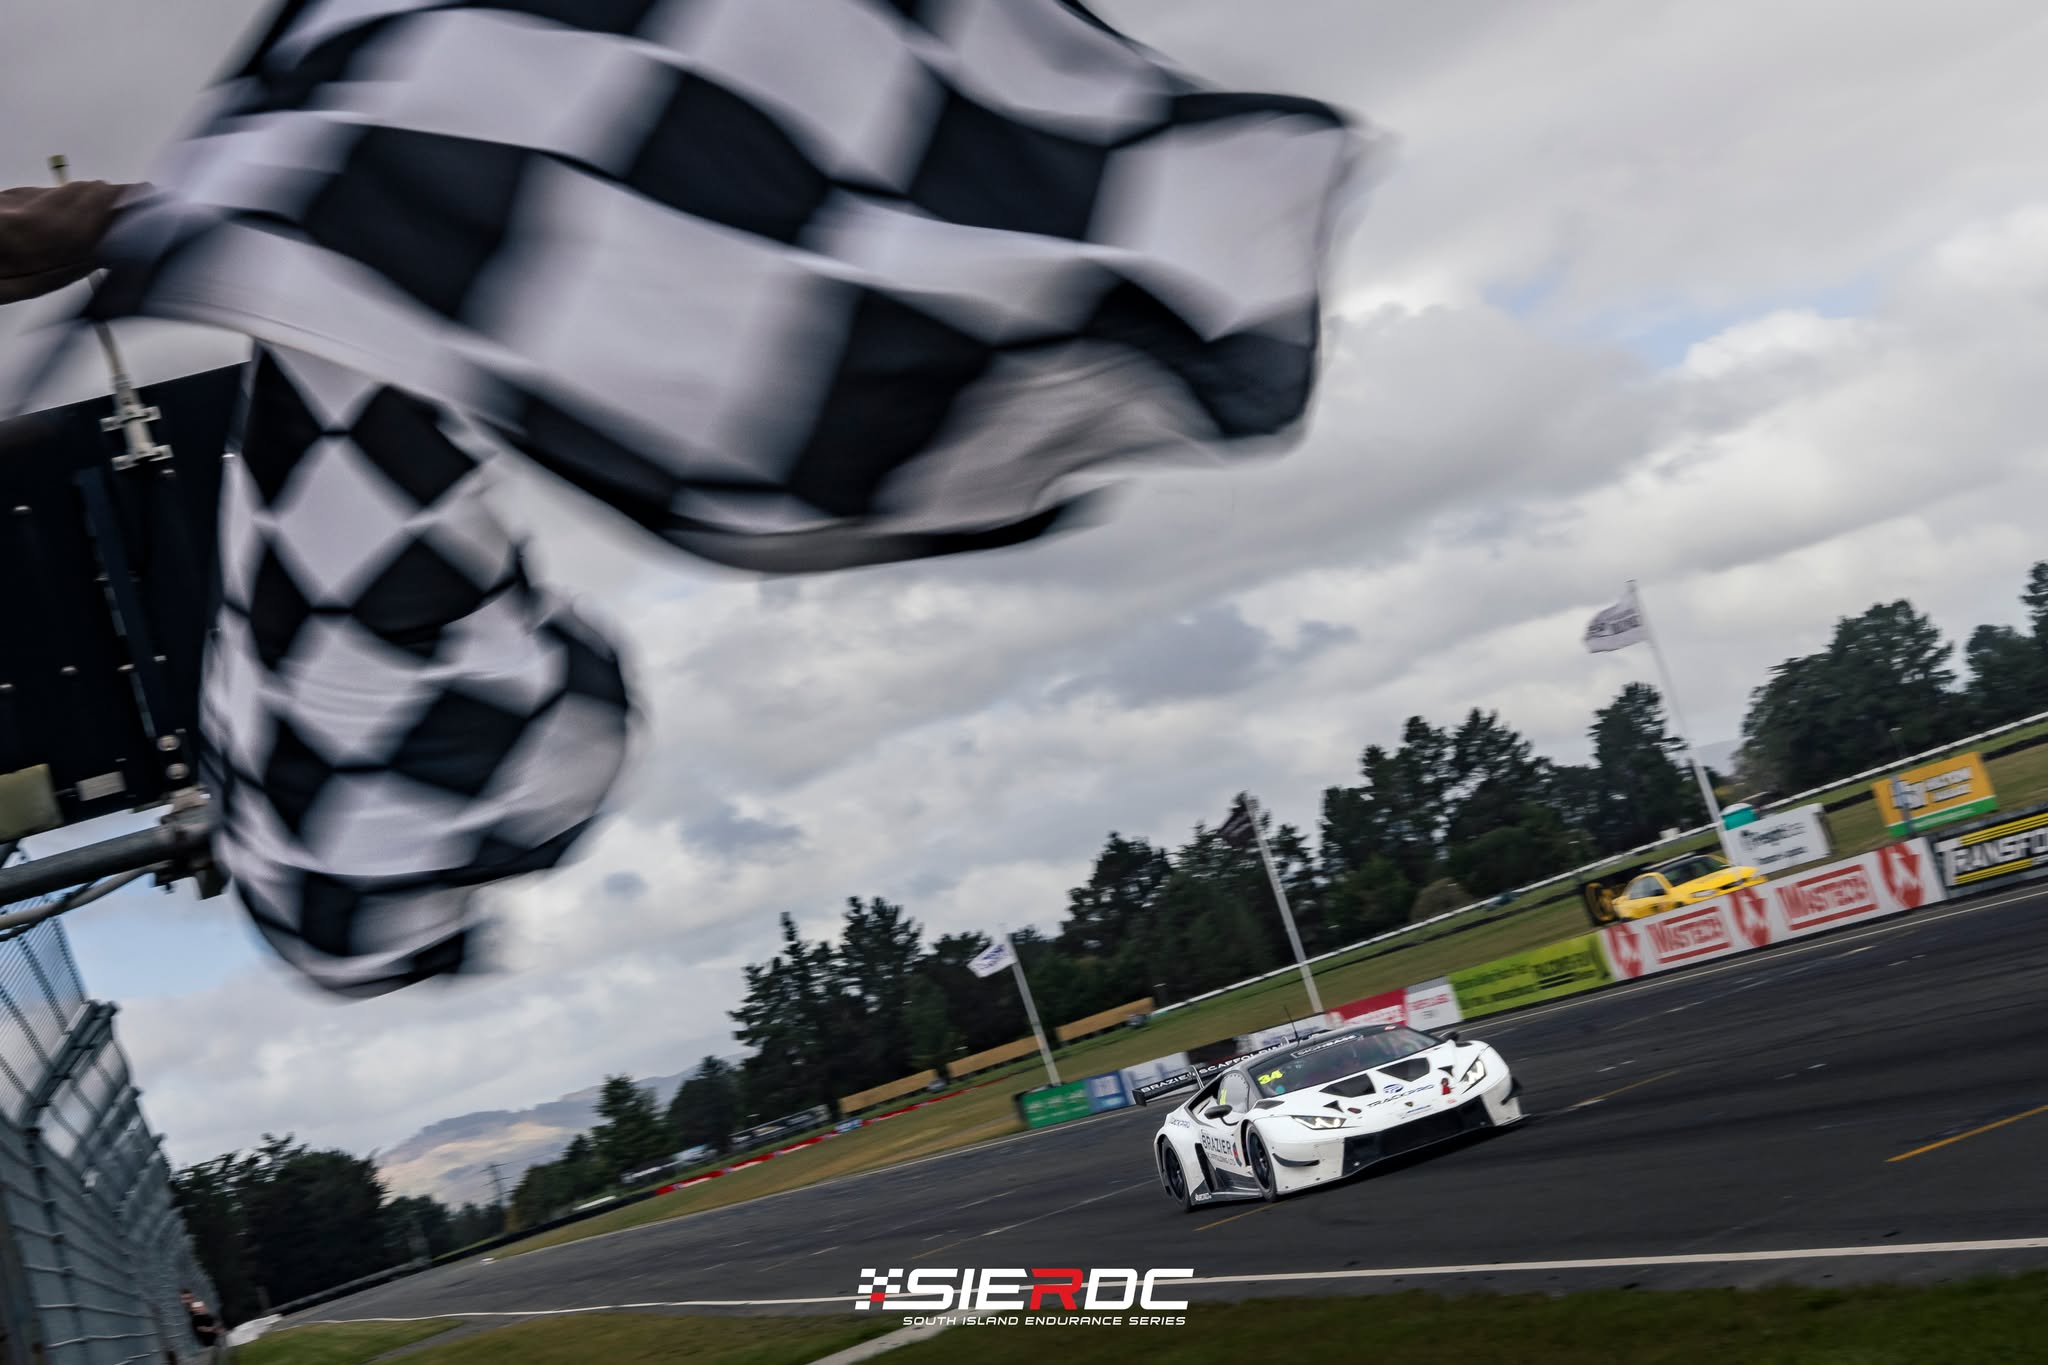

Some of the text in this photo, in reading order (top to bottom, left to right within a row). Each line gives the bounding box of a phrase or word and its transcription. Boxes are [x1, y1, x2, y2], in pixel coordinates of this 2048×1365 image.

[1199, 1042, 1285, 1074] SCAFFOLDIN
[1258, 1069, 1283, 1085] 34
[1201, 1134, 1233, 1156] BRAZIER
